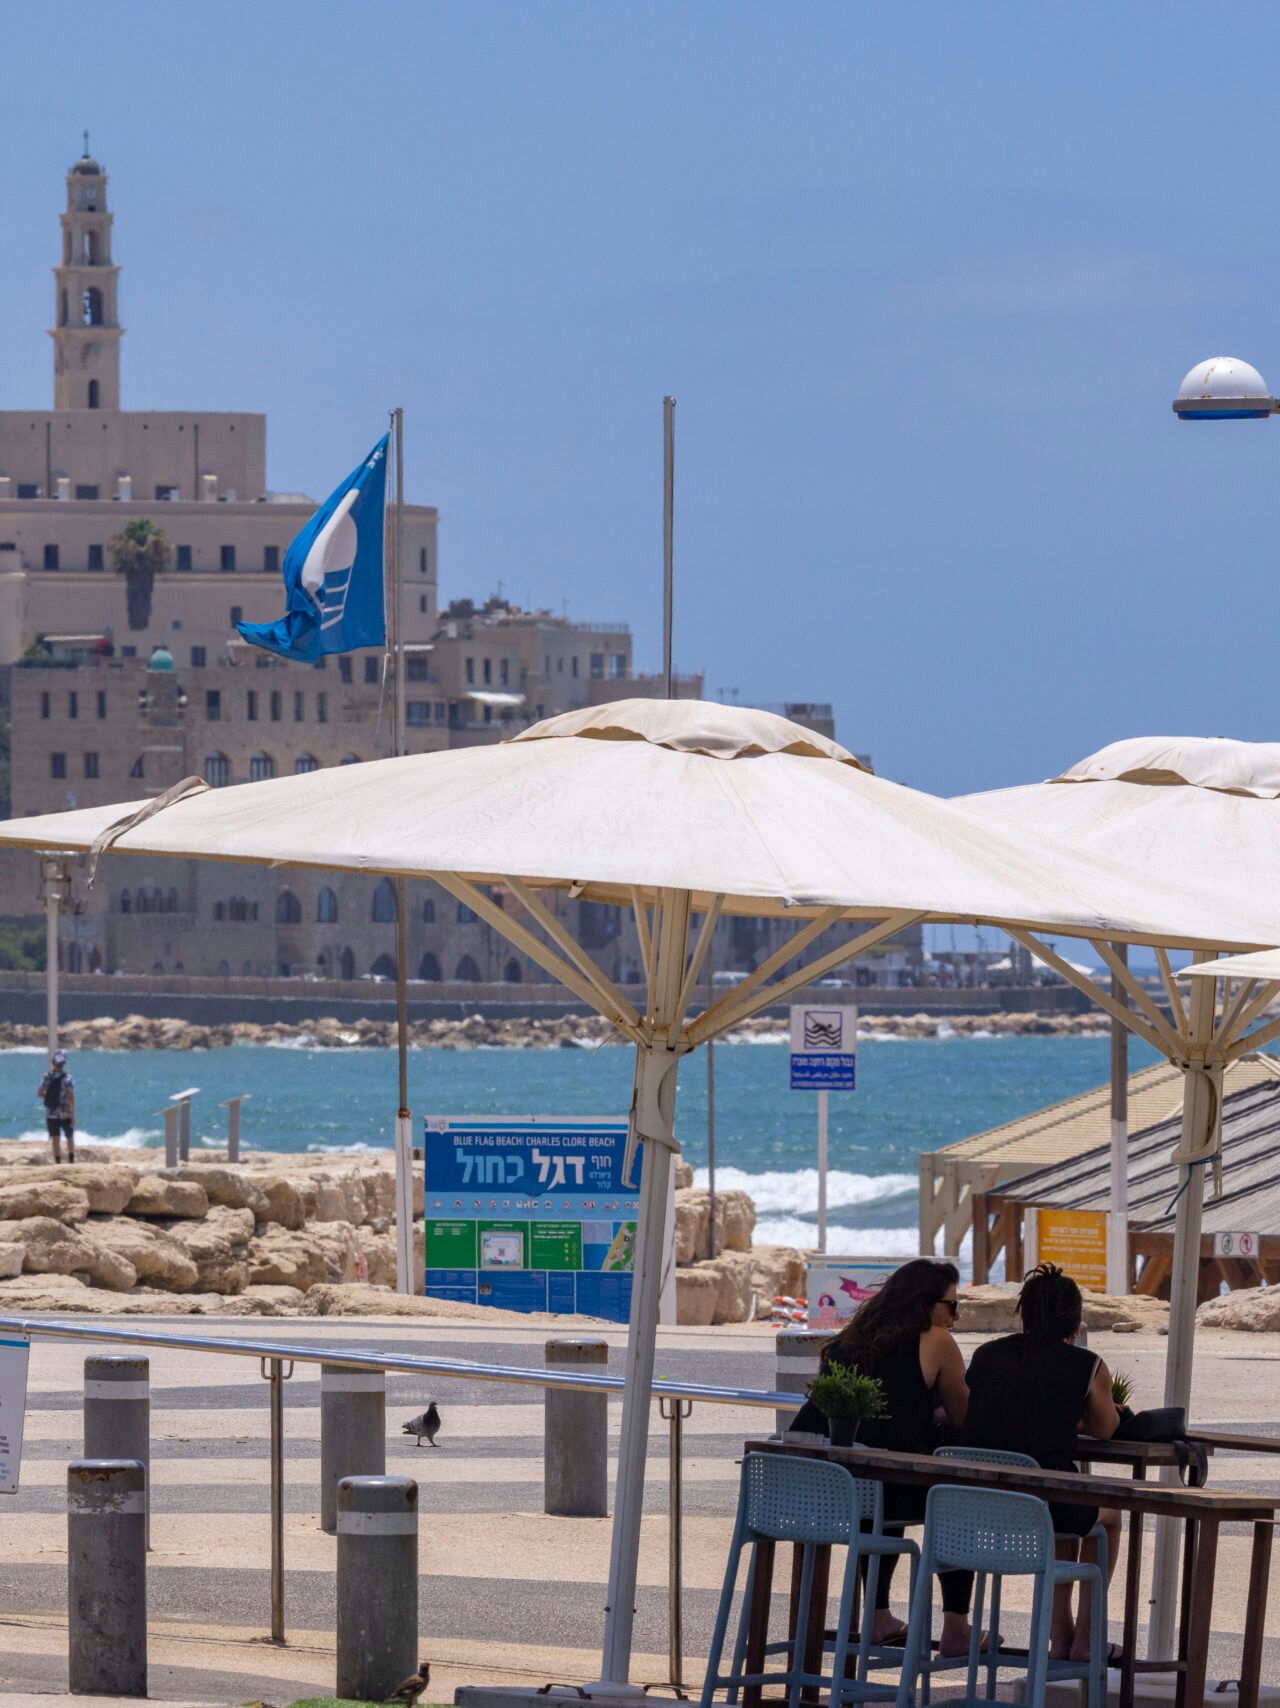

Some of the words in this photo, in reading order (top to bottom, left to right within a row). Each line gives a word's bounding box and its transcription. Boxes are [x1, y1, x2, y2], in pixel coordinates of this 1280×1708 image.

[453, 1136, 473, 1146] BLUE
[475, 1136, 494, 1146] FLAG
[496, 1136, 521, 1146] BEACH
[525, 1136, 560, 1147] CHARLES
[562, 1137, 587, 1147] CLORE
[589, 1137, 615, 1147] BEACH
[456, 1148, 524, 1184] כחול
[532, 1148, 585, 1190] דגל
[591, 1155, 612, 1170] חוף
